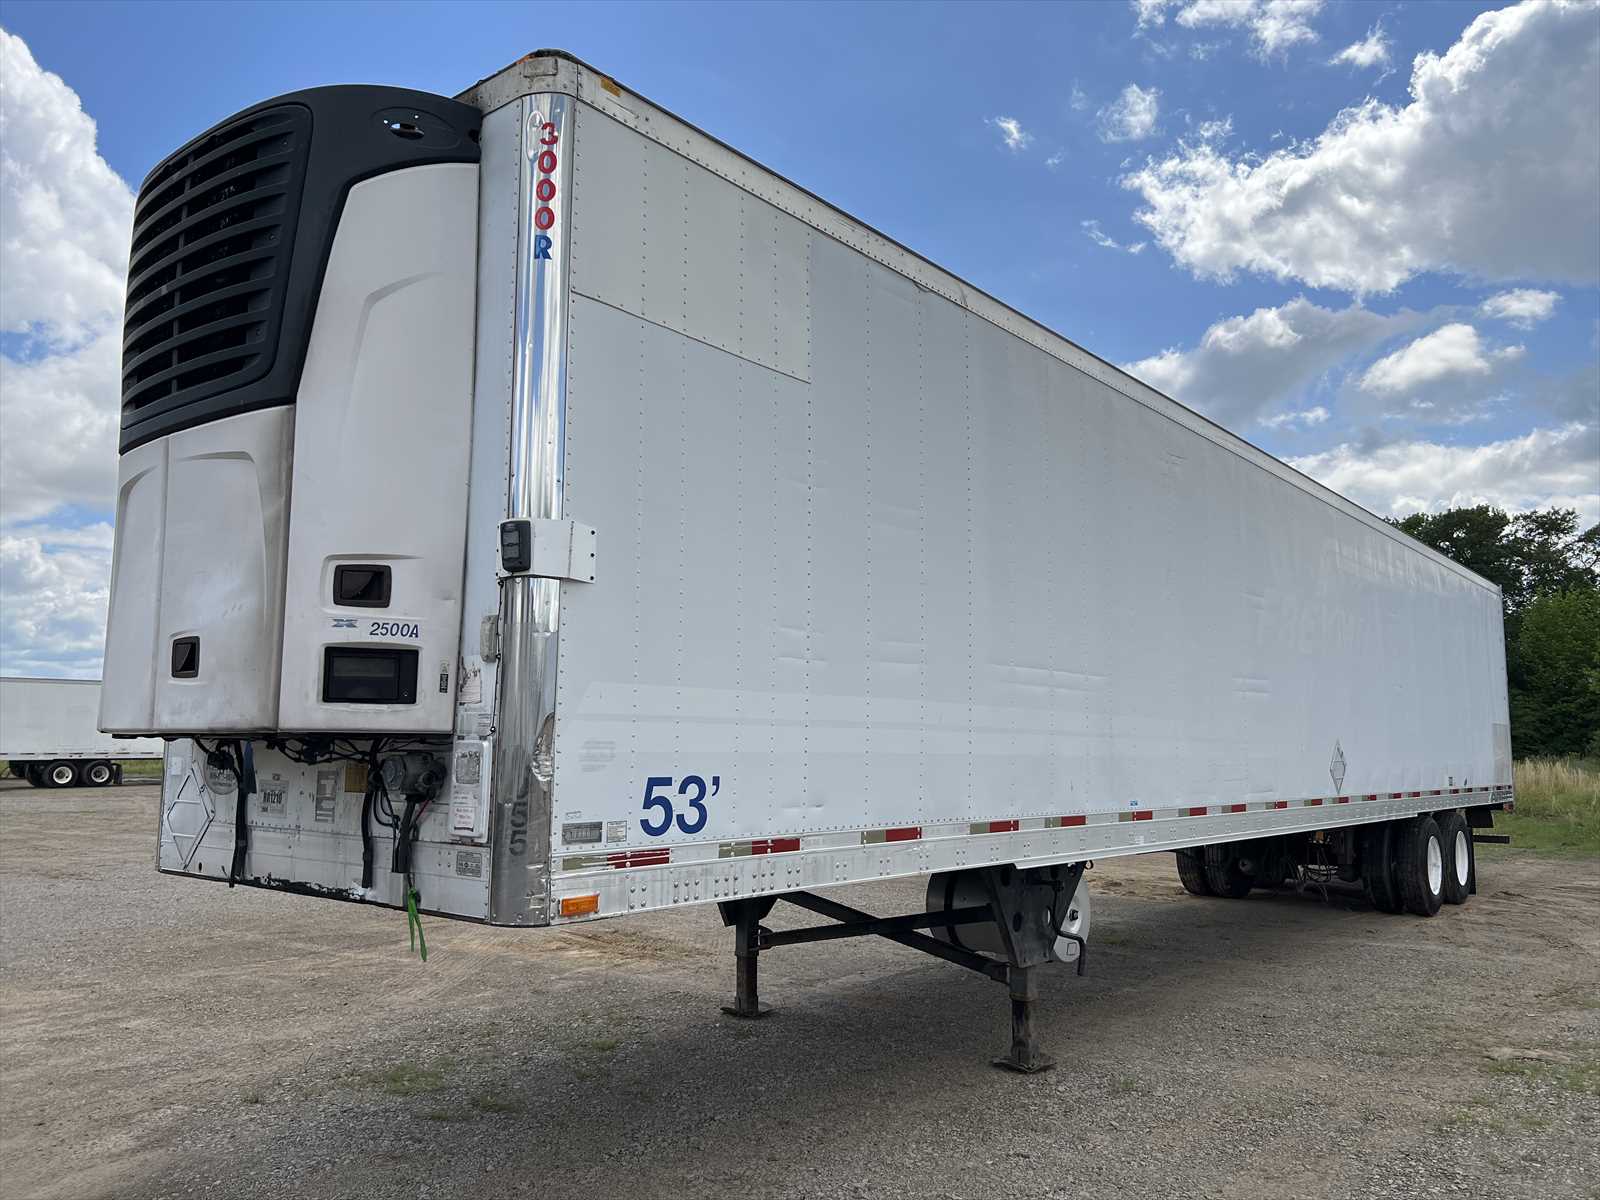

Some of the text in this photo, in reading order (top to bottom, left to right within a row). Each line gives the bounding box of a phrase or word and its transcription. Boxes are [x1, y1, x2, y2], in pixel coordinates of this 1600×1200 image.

[533, 122, 559, 260] 3000R
[369, 622, 419, 638] 2500A
[639, 775, 720, 837] 53'
